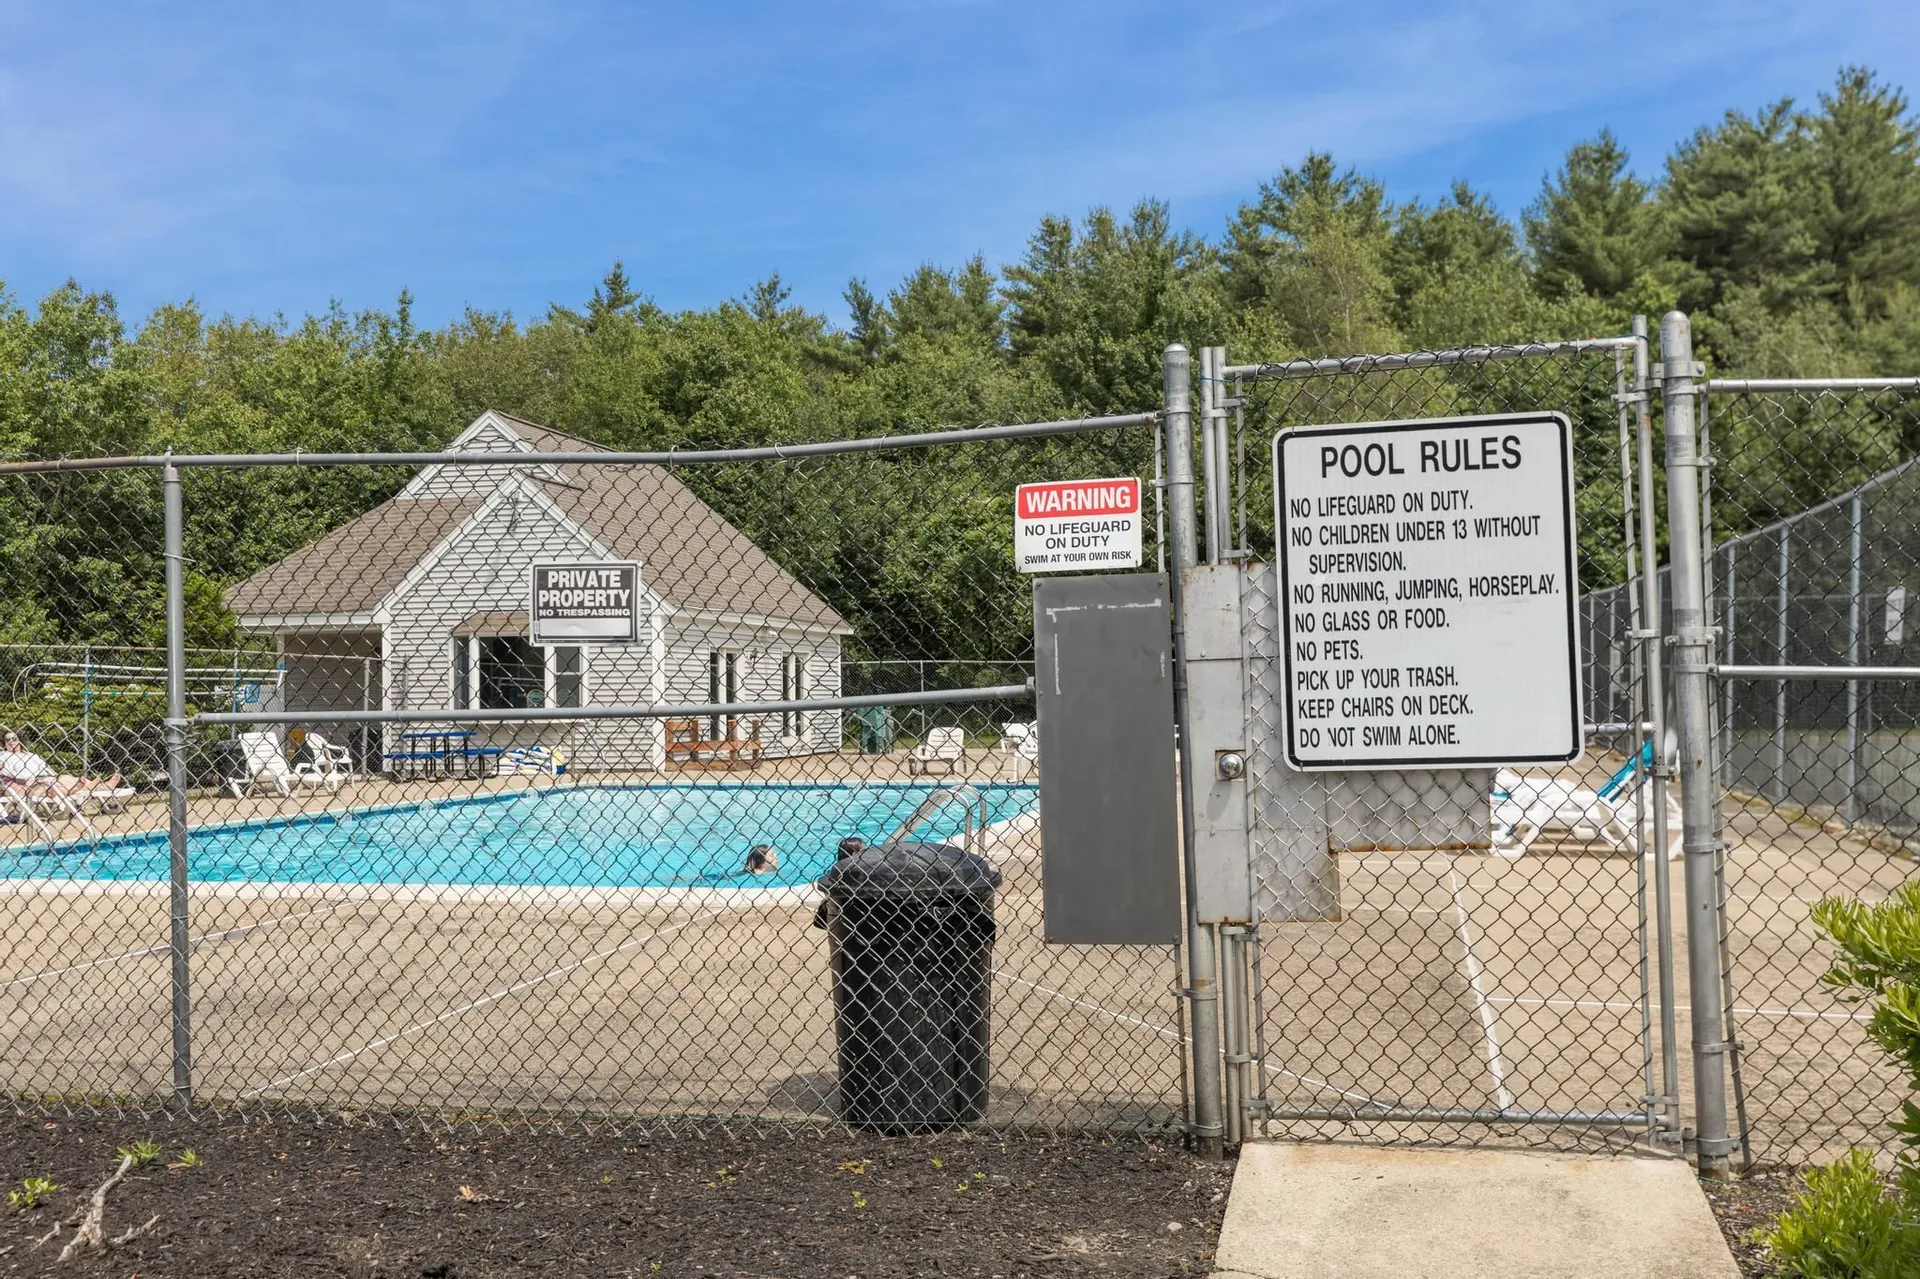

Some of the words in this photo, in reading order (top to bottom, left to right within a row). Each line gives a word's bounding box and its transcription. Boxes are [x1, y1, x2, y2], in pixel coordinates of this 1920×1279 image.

[1321, 443, 1404, 478] POOL
[1421, 435, 1521, 472] RULES
[1026, 486, 1130, 513] WARNING
[1291, 498, 1310, 518] NO
[1318, 494, 1395, 516] LIFEGUARD
[1403, 493, 1423, 512] ON
[1431, 490, 1473, 511] DUTY.
[1025, 525, 1045, 536] NO
[1050, 520, 1131, 534] LIFEGUARD
[1292, 526, 1312, 546] NO
[1319, 523, 1389, 545] CHILDREN
[1397, 521, 1445, 541] UNDER
[1452, 519, 1467, 539] 13
[1474, 516, 1540, 538] WITHOUT
[1046, 538, 1066, 549] ON
[1071, 535, 1109, 547] DUTY
[1025, 555, 1048, 564] SWIM
[1051, 554, 1060, 562] AT
[1064, 553, 1088, 562] YOUR
[1089, 552, 1108, 561] OWN
[1112, 551, 1131, 560] RISK
[1309, 551, 1406, 574] SUPERVISION.
[548, 570, 621, 587] PRIVATE
[1294, 584, 1314, 604] NO
[1321, 581, 1388, 604] RUNNING,
[1395, 578, 1462, 601] JUMPING,
[1469, 574, 1559, 597] HORSEPLAY.
[539, 589, 630, 607] PROPERTY
[1295, 613, 1315, 632] NO
[1323, 611, 1370, 631] GLASS
[1378, 610, 1398, 629] OR
[1405, 608, 1449, 629] FOOD.
[1297, 641, 1316, 661] NO
[1324, 640, 1363, 660] PETS.
[1298, 670, 1329, 690] PICK
[1336, 669, 1354, 689] UP
[1361, 668, 1399, 688] YOUR
[1406, 666, 1458, 687] TRASH.
[1299, 698, 1334, 719] KEEP
[1342, 697, 1393, 718] CHAIRS
[1401, 696, 1422, 716] ON
[1430, 694, 1473, 715] DECK.
[1300, 728, 1320, 747] DO
[1328, 727, 1355, 747] NOT
[1362, 726, 1400, 746] SWIM
[1408, 724, 1460, 745] ALONE.
